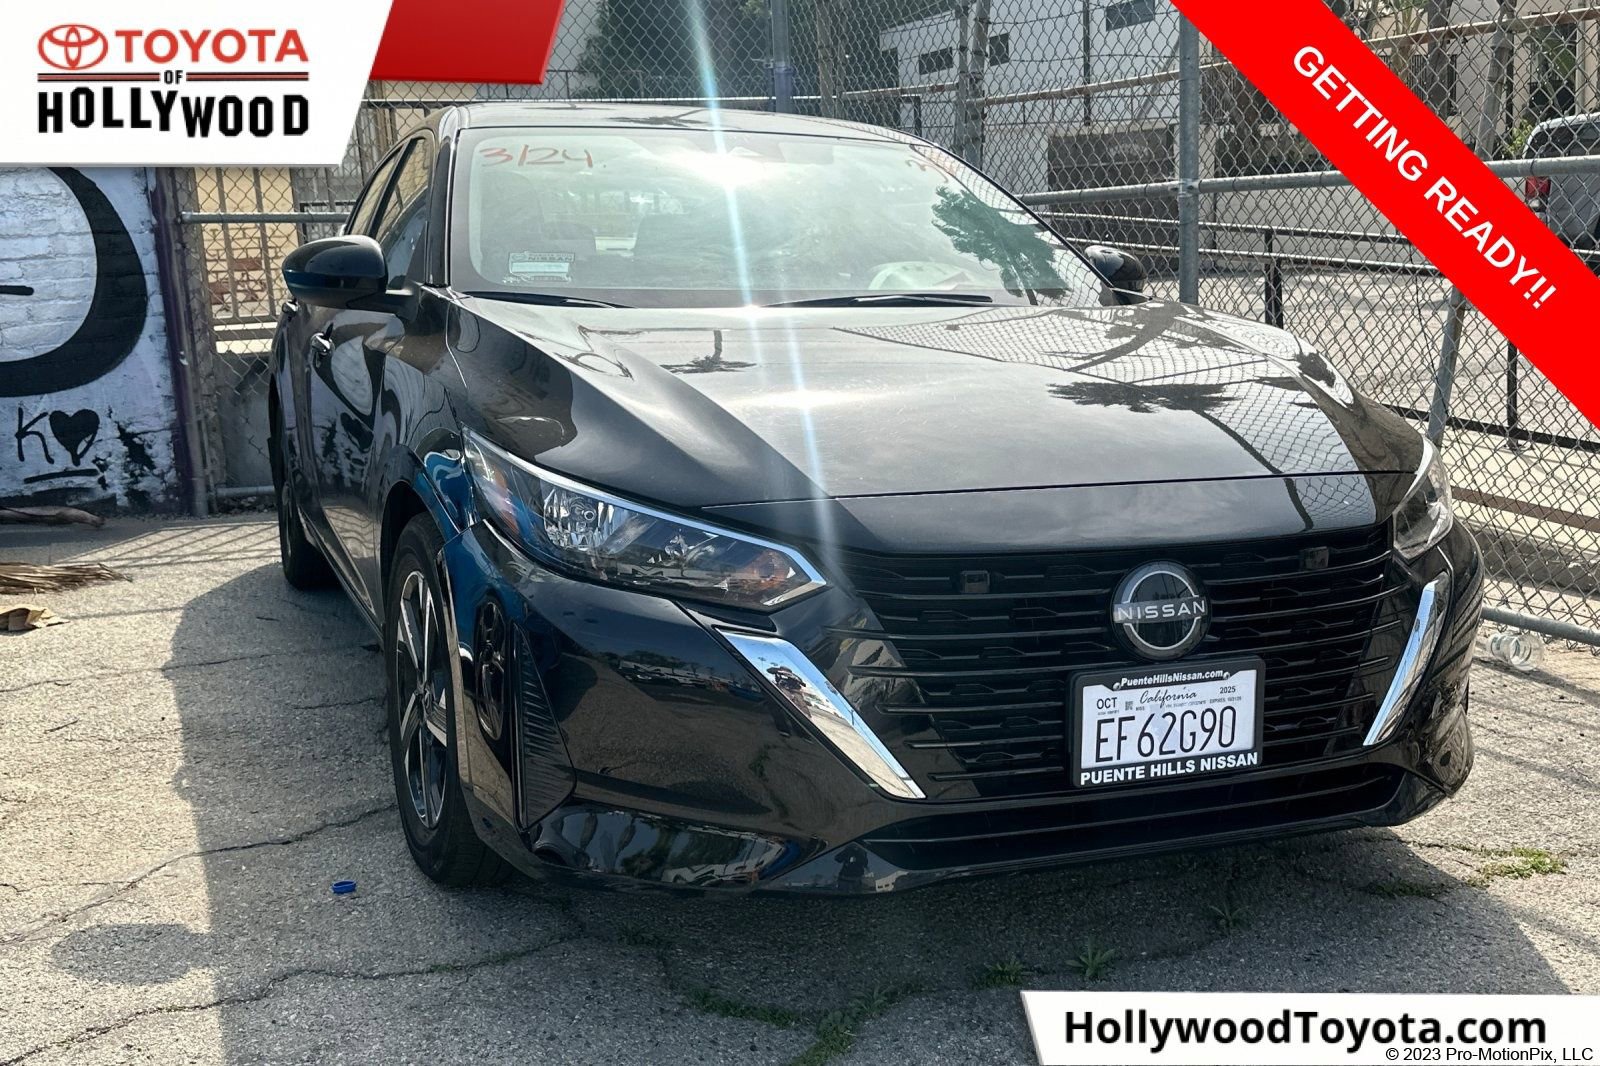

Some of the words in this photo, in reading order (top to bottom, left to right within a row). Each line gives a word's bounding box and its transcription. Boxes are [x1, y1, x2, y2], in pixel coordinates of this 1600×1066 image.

[1117, 600, 1205, 621] NISSAN
[1120, 669, 1224, 688] PuenteHillsNissan.com
[1139, 686, 1197, 709] California
[1219, 685, 1237, 694] 2025
[1096, 696, 1118, 710] OCT
[1095, 705, 1237, 763] EF62G90
[1080, 765, 1146, 786] PUENTE
[1150, 759, 1196, 778] HILLS
[1200, 751, 1258, 772] NISSAN
